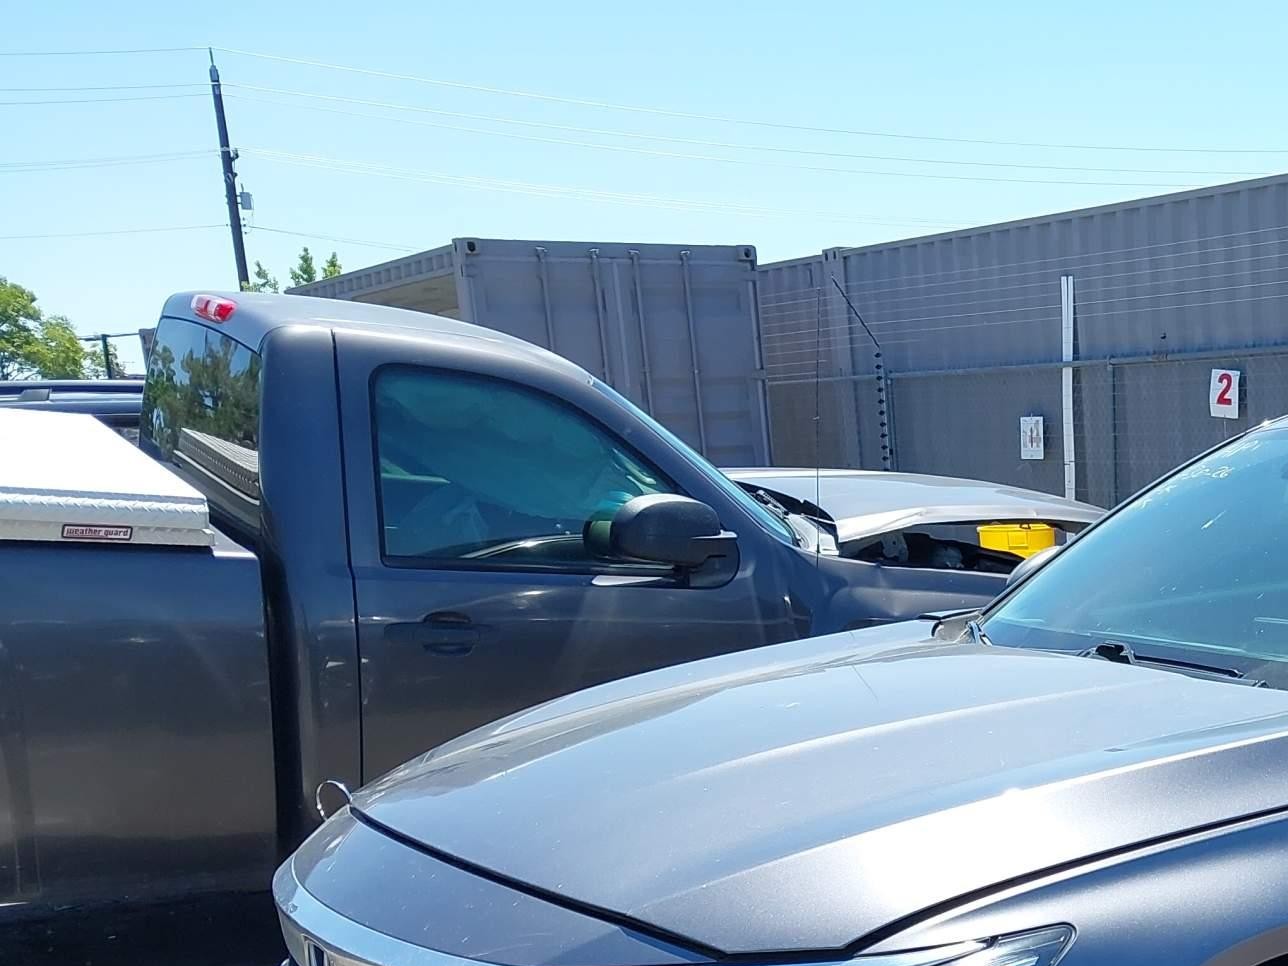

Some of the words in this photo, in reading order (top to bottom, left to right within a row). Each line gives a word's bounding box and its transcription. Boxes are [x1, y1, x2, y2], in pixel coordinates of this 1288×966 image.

[1216, 372, 1233, 406] 2
[65, 527, 102, 537] weather
[103, 528, 129, 537] guard
